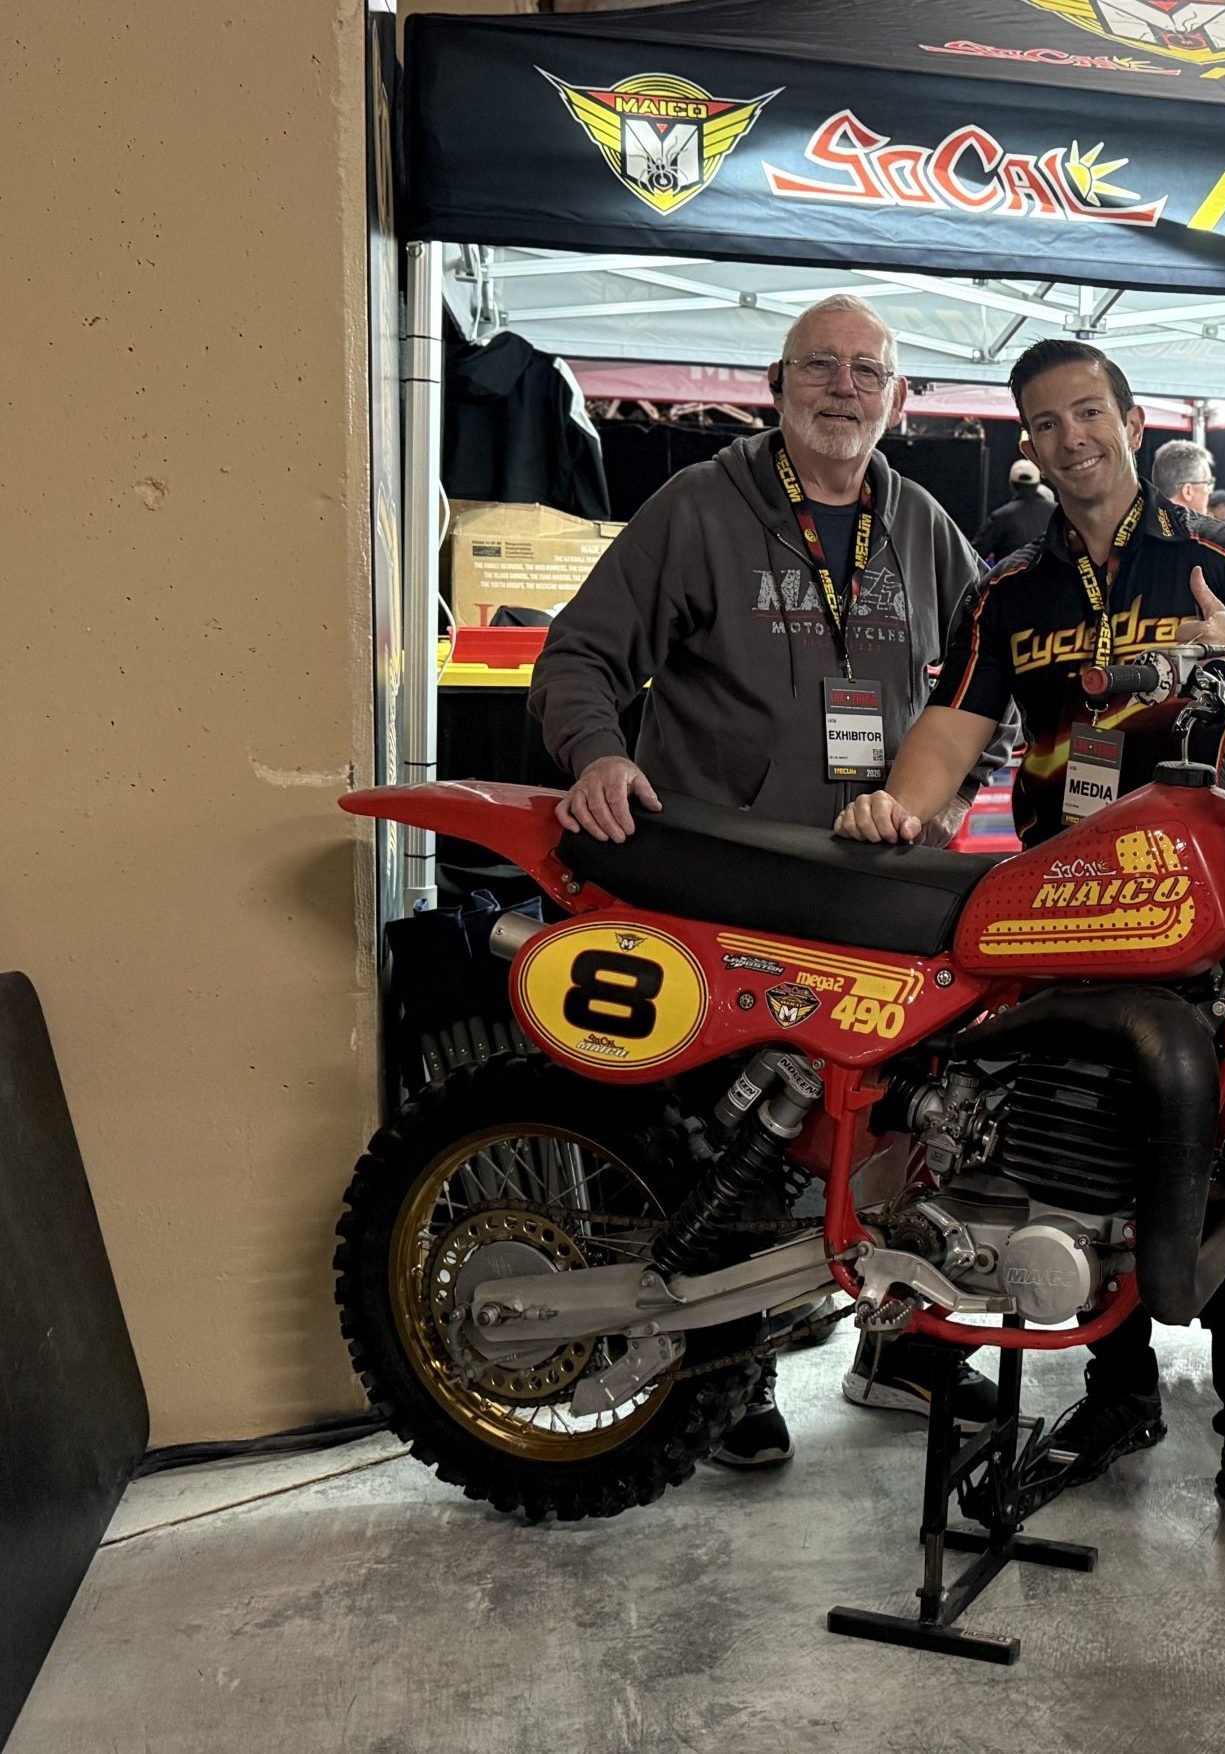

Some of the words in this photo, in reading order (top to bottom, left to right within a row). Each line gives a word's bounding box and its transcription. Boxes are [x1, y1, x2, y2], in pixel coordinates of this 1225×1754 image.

[615, 96, 709, 119] MAICO
[775, 448, 802, 503] MECUM
[855, 514, 872, 569] MECUM
[1114, 498, 1144, 547] MECUM
[1077, 556, 1105, 611] MECUM
[772, 621, 906, 643] MOTOYCLES
[828, 730, 882, 742] EXHIBITOR
[1069, 779, 1113, 801] MEDIA
[1031, 875, 1192, 909] MAICO
[563, 949, 664, 1040] 8
[830, 994, 905, 1039] 490
[780, 1058, 817, 1094] NOLEEN
